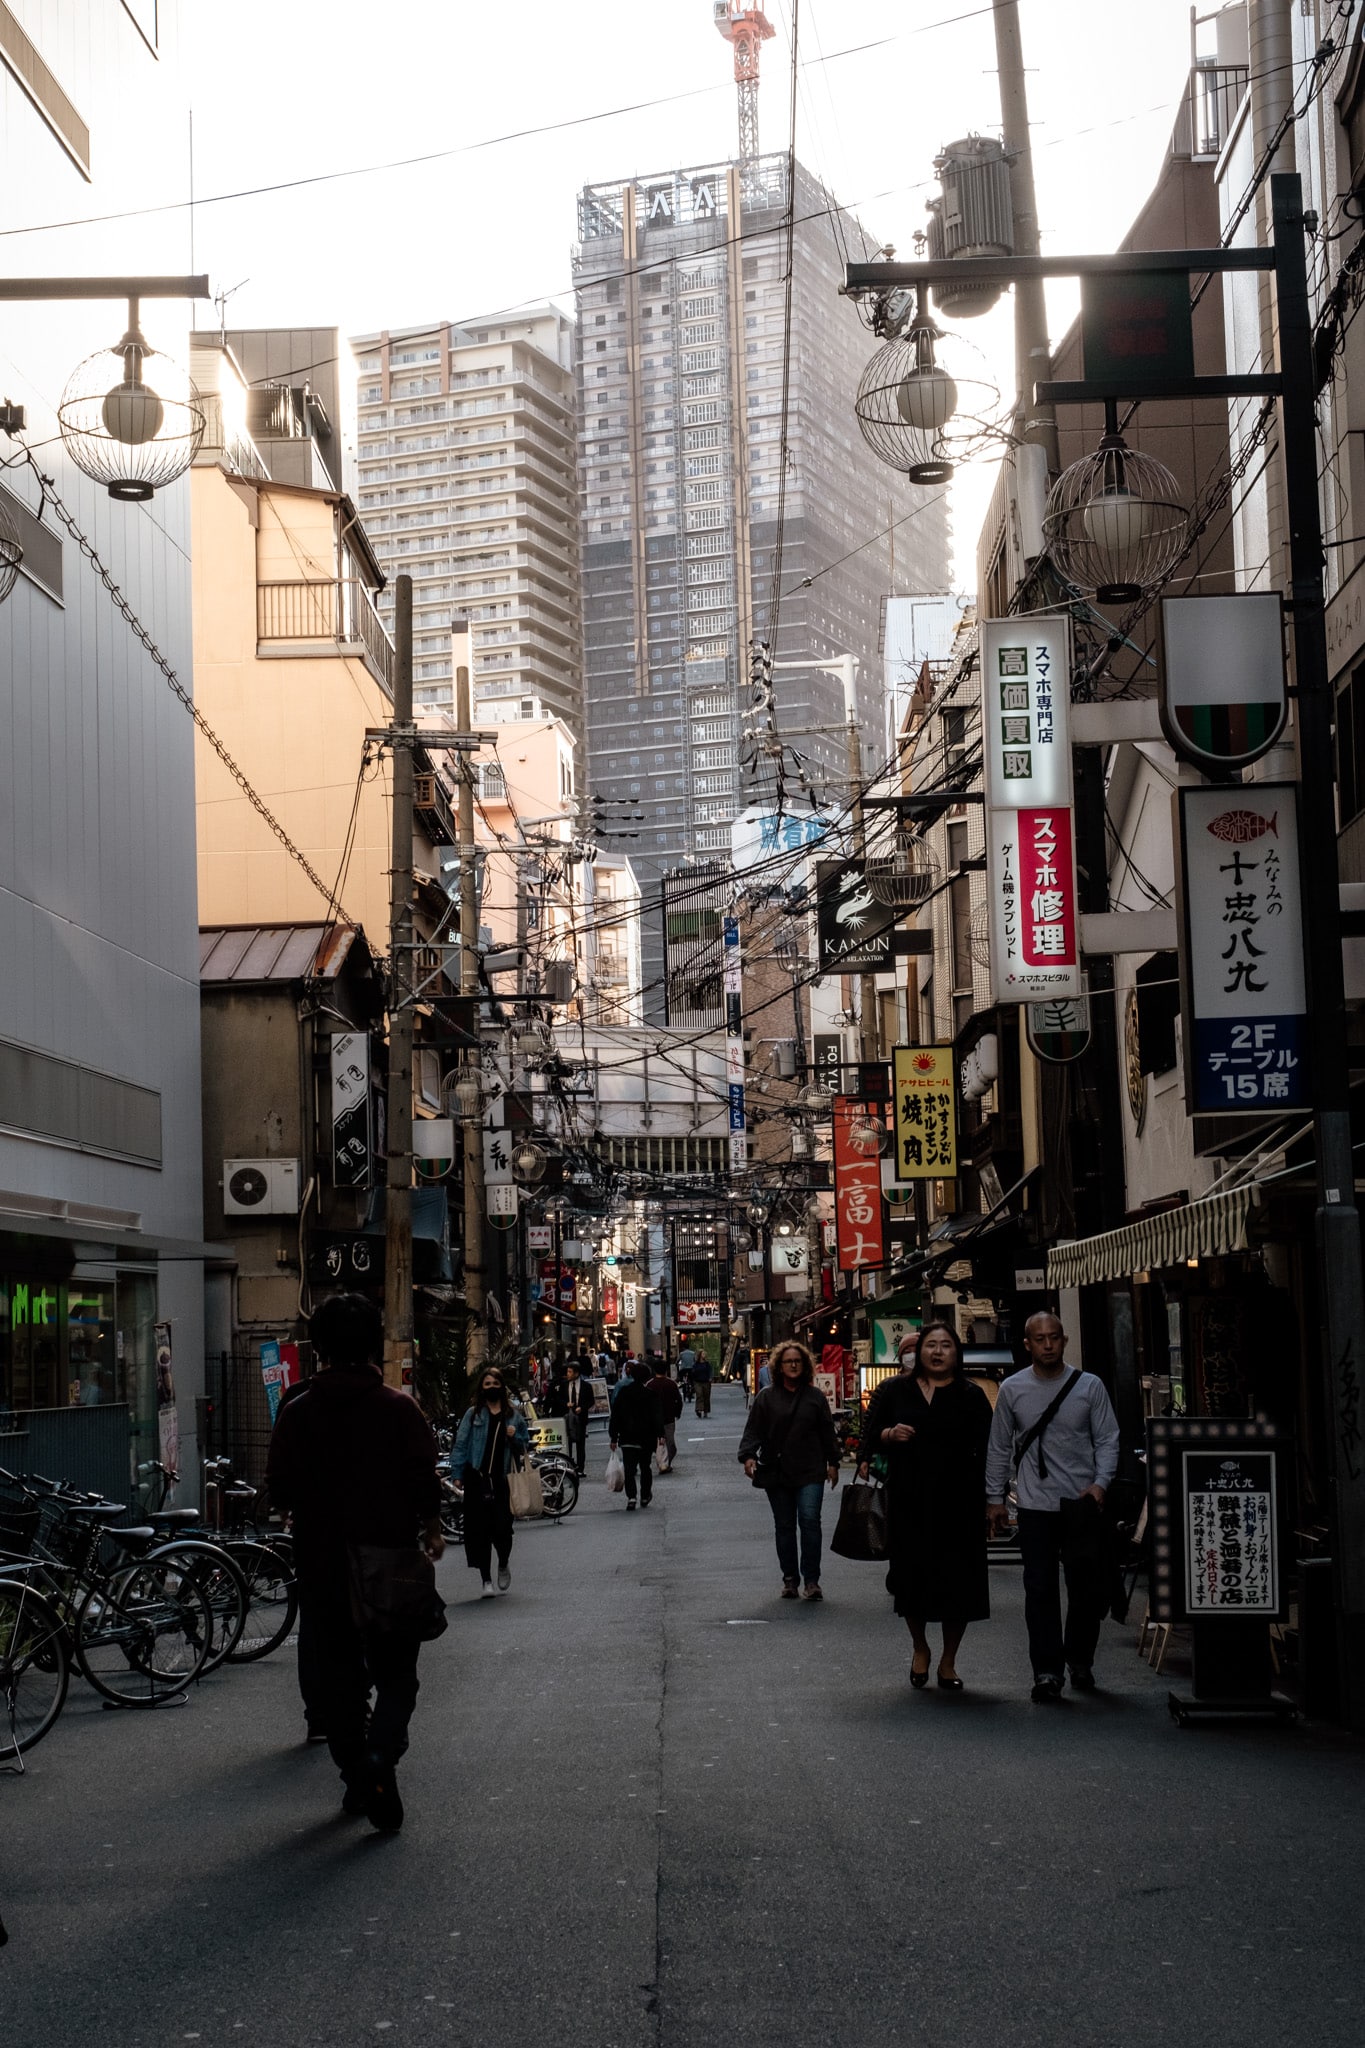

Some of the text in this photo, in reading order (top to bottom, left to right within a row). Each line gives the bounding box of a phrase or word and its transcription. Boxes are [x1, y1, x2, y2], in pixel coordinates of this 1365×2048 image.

[1001, 651, 1031, 777] 高価買取
[1035, 646, 1054, 744] スマホ専門店
[1032, 817, 1066, 957] スマホ修理
[1265, 849, 1287, 916] みなみの
[1219, 851, 1269, 993] 十忠八九
[827, 1045, 838, 1078] FOY
[1208, 1050, 1300, 1074] テーブル
[1231, 1025, 1277, 1050] 2F
[1221, 1073, 1291, 1100] 15席
[901, 1094, 923, 1166] 焼肉
[923, 1093, 938, 1166] ホルモン
[937, 1093, 951, 1166] かすうどん
[1206, 1549, 1219, 1605] 定休日なし
